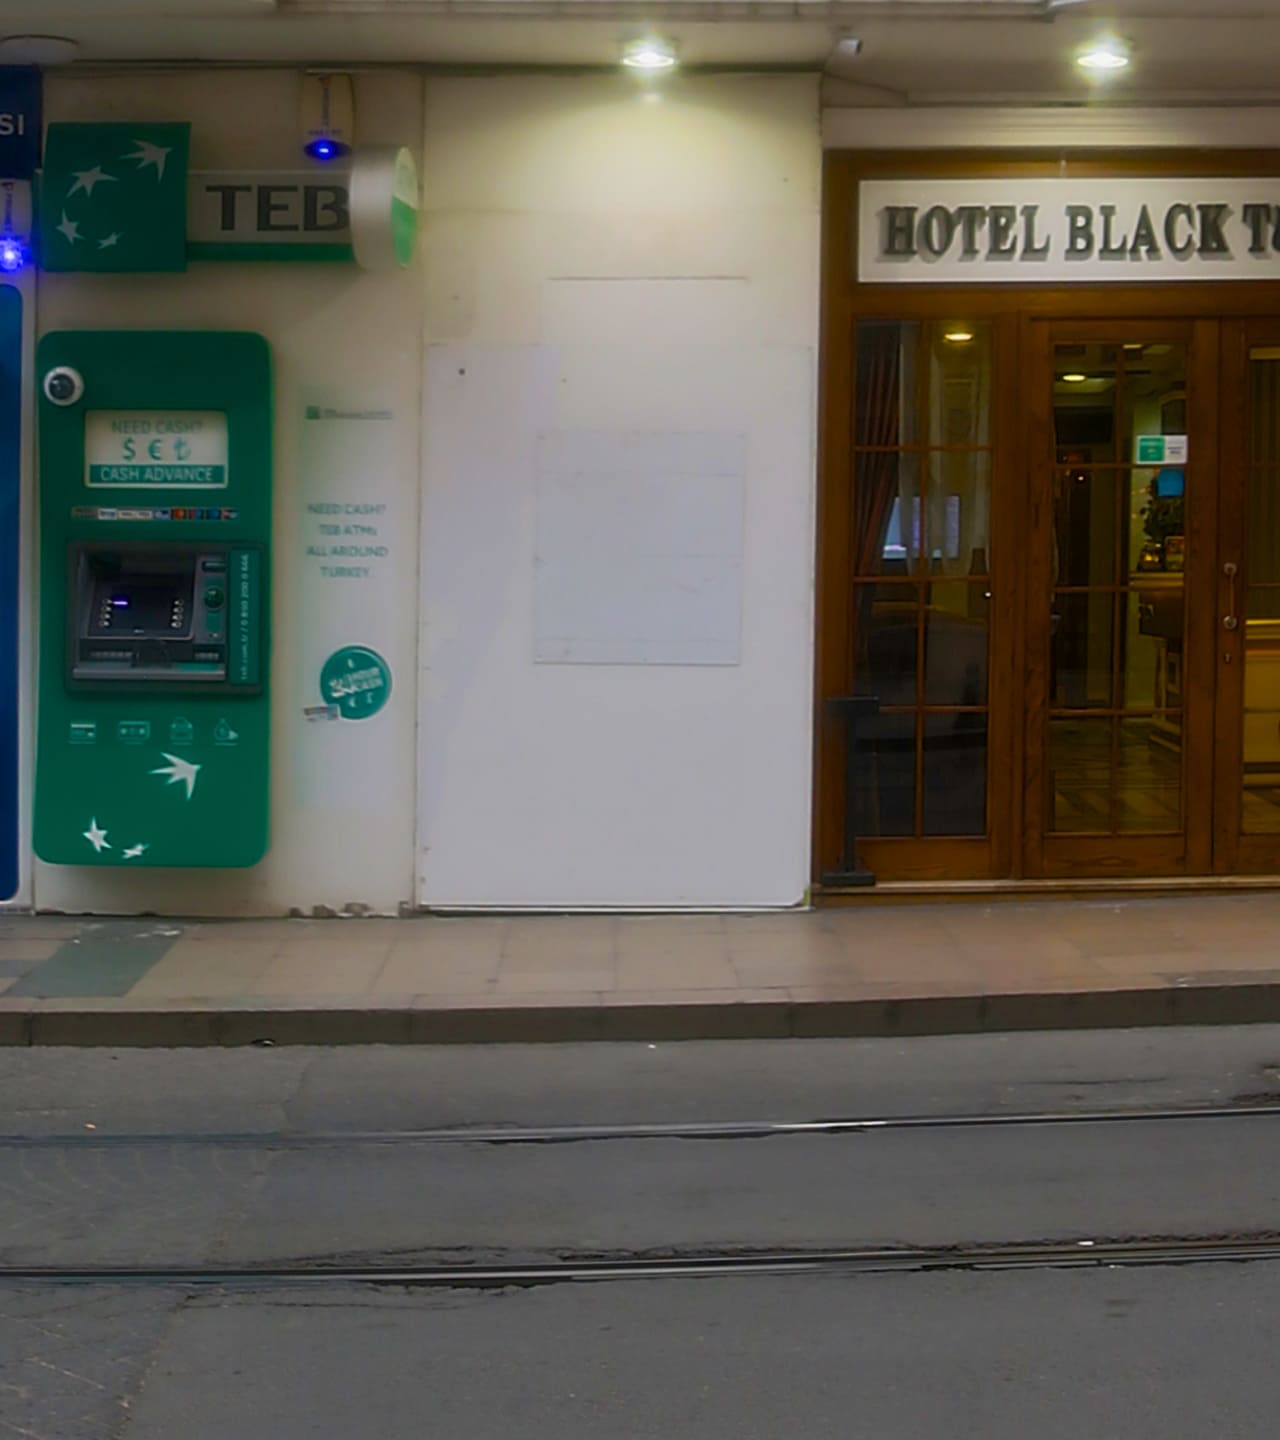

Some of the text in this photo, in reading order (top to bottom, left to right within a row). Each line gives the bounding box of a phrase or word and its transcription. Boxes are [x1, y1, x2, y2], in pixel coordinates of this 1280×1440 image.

[206, 185, 351, 231] TEB
[884, 204, 1051, 258] HOTEL
[1065, 202, 1230, 255] BLACK
[112, 420, 151, 434] NEED
[122, 437, 136, 461] $
[148, 439, 163, 461] €
[100, 467, 213, 482] CASH ADVANCE
[306, 545, 389, 557] ALL AROUND
